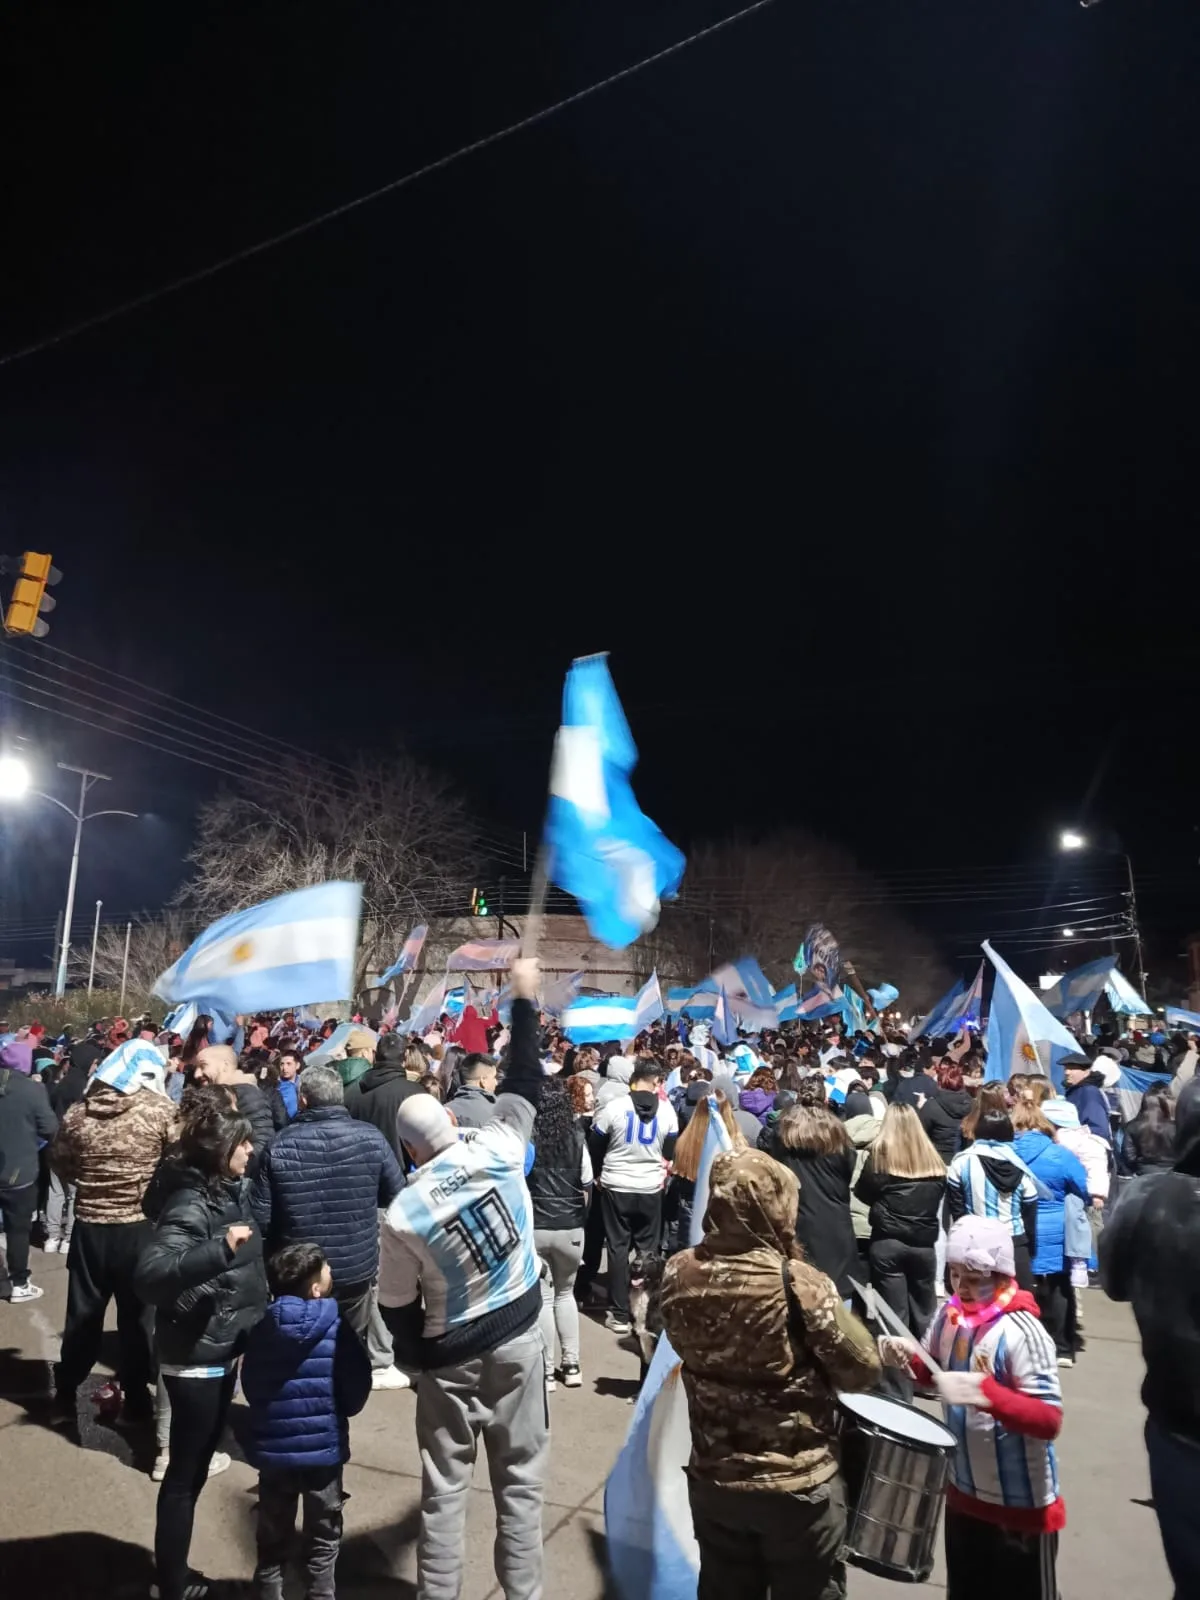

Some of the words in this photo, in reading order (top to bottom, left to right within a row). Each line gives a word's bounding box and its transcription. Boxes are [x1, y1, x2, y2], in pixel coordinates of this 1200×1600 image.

[625, 1111, 658, 1145] 10
[429, 1166, 472, 1205] MESSI
[443, 1186, 520, 1274] 10
